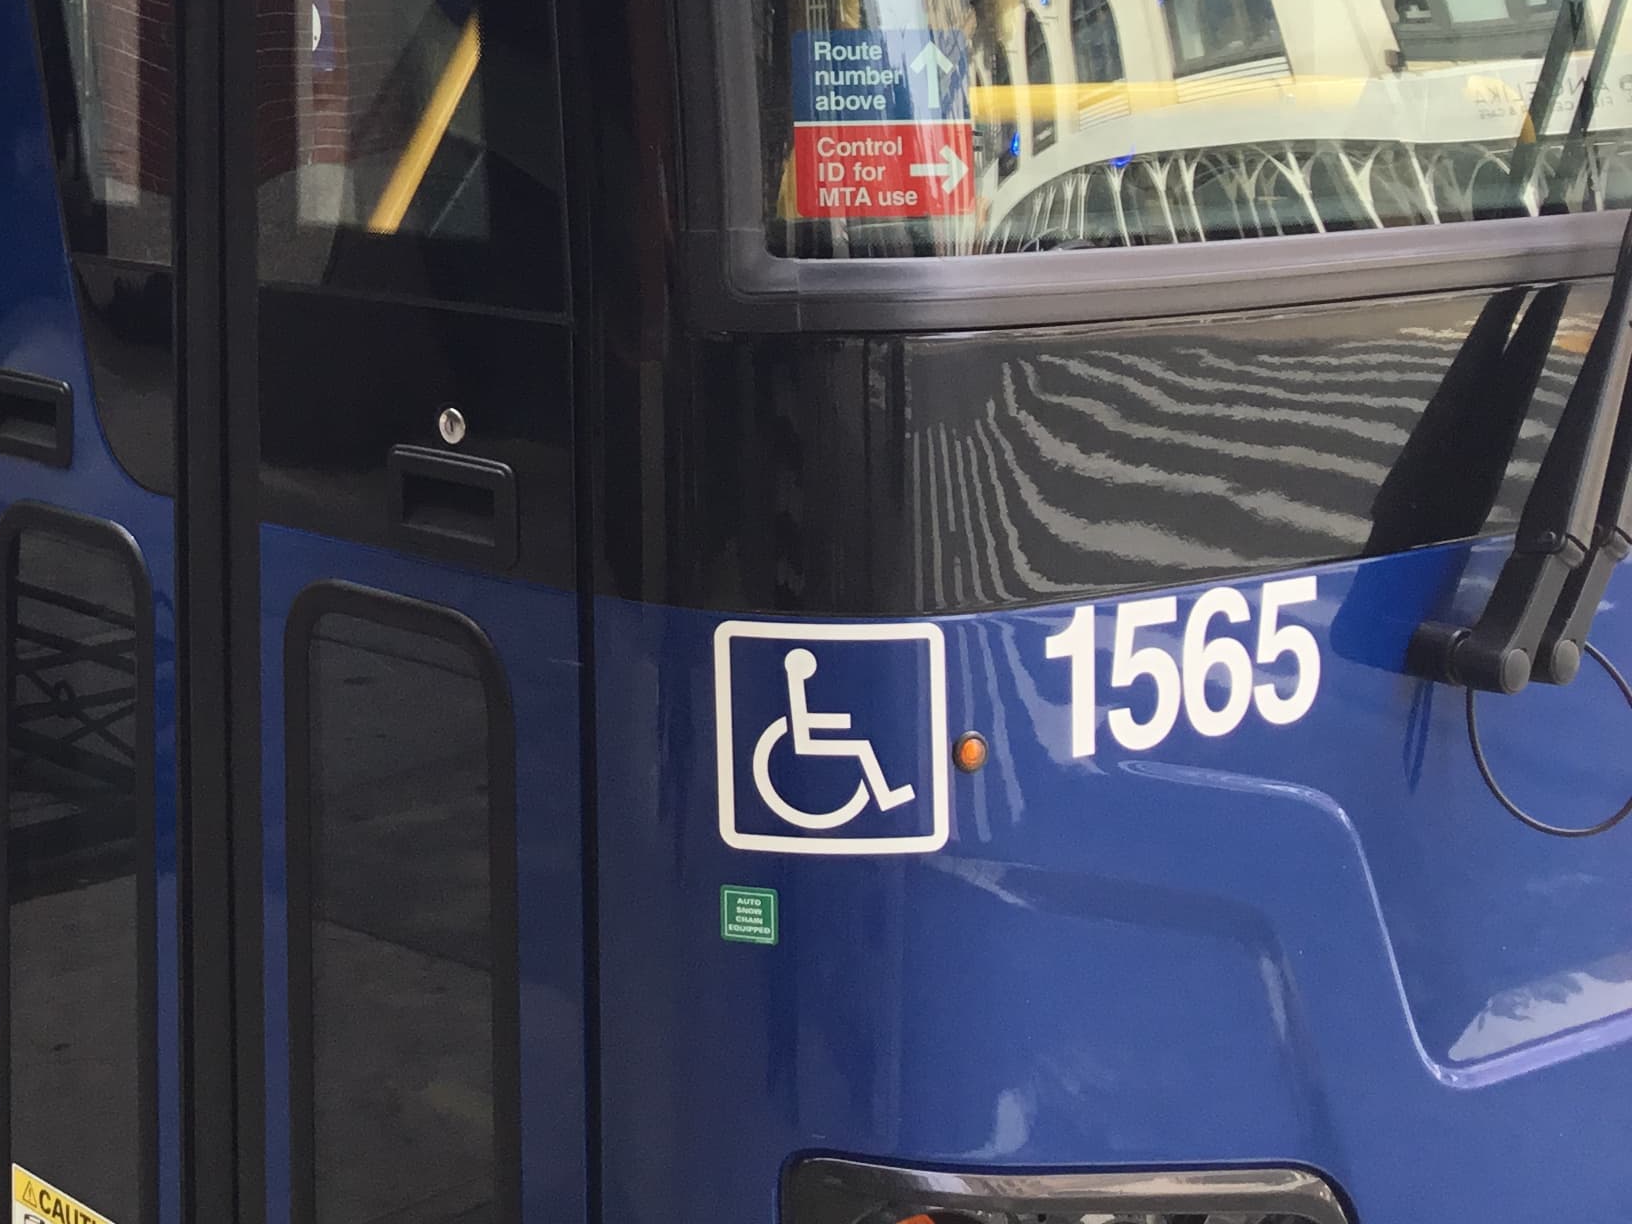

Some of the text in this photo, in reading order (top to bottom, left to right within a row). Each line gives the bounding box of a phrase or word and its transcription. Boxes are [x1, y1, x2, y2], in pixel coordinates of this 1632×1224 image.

[814, 41, 882, 61] Route
[815, 67, 903, 86] number
[815, 91, 887, 111] above
[818, 136, 903, 157] Control
[820, 162, 886, 182] ID for
[820, 187, 918, 207] MTA use
[1045, 576, 1320, 758] 1565
[736, 906, 763, 916] SNOW
[737, 897, 762, 906] AUTO
[728, 923, 771, 934] EQUIPPED
[735, 915, 764, 925] CHAIN
